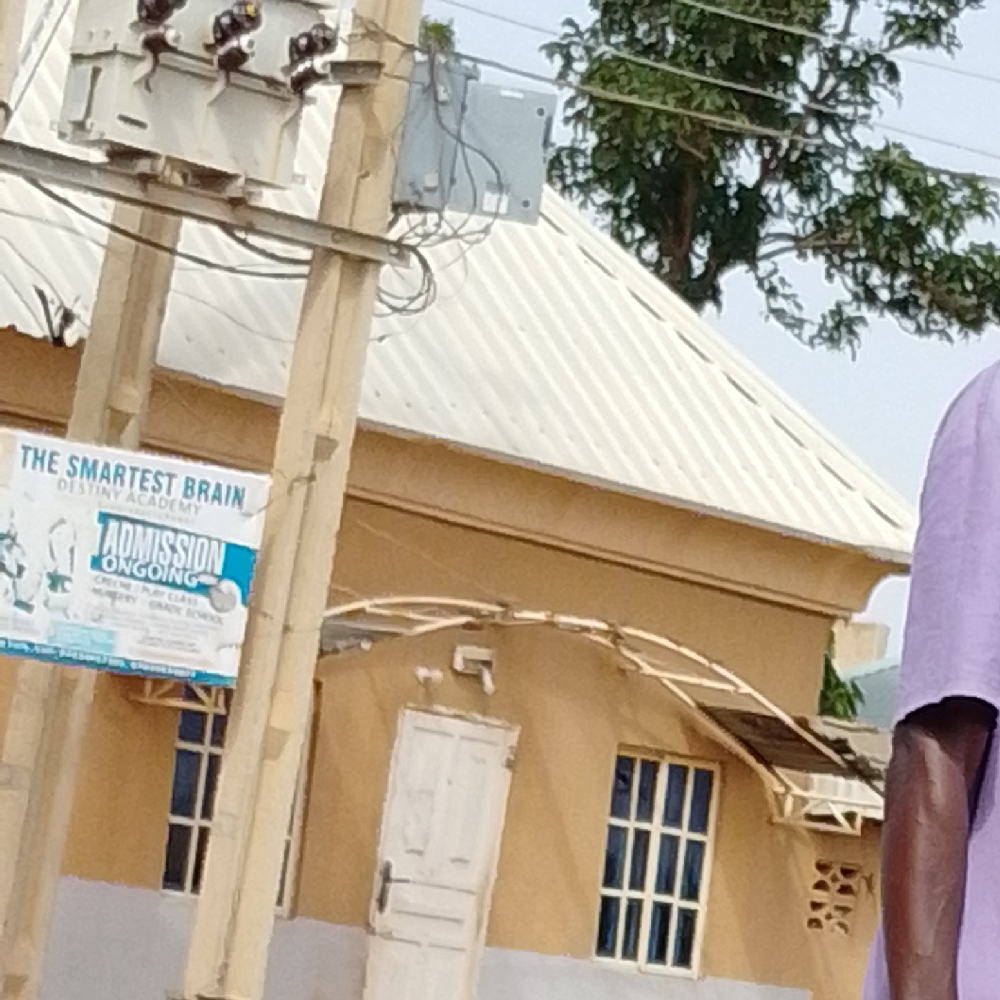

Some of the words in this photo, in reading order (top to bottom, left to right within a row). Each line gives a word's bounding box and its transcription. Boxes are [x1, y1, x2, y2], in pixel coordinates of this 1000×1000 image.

[20, 444, 60, 475] THE
[66, 454, 178, 496] SMARTEST
[182, 475, 247, 511] BRAIN
[57, 478, 121, 502] DESTINY
[126, 491, 202, 515] ACADEMY
[101, 519, 223, 576] ADMISSION
[101, 555, 199, 588] ONGOING
